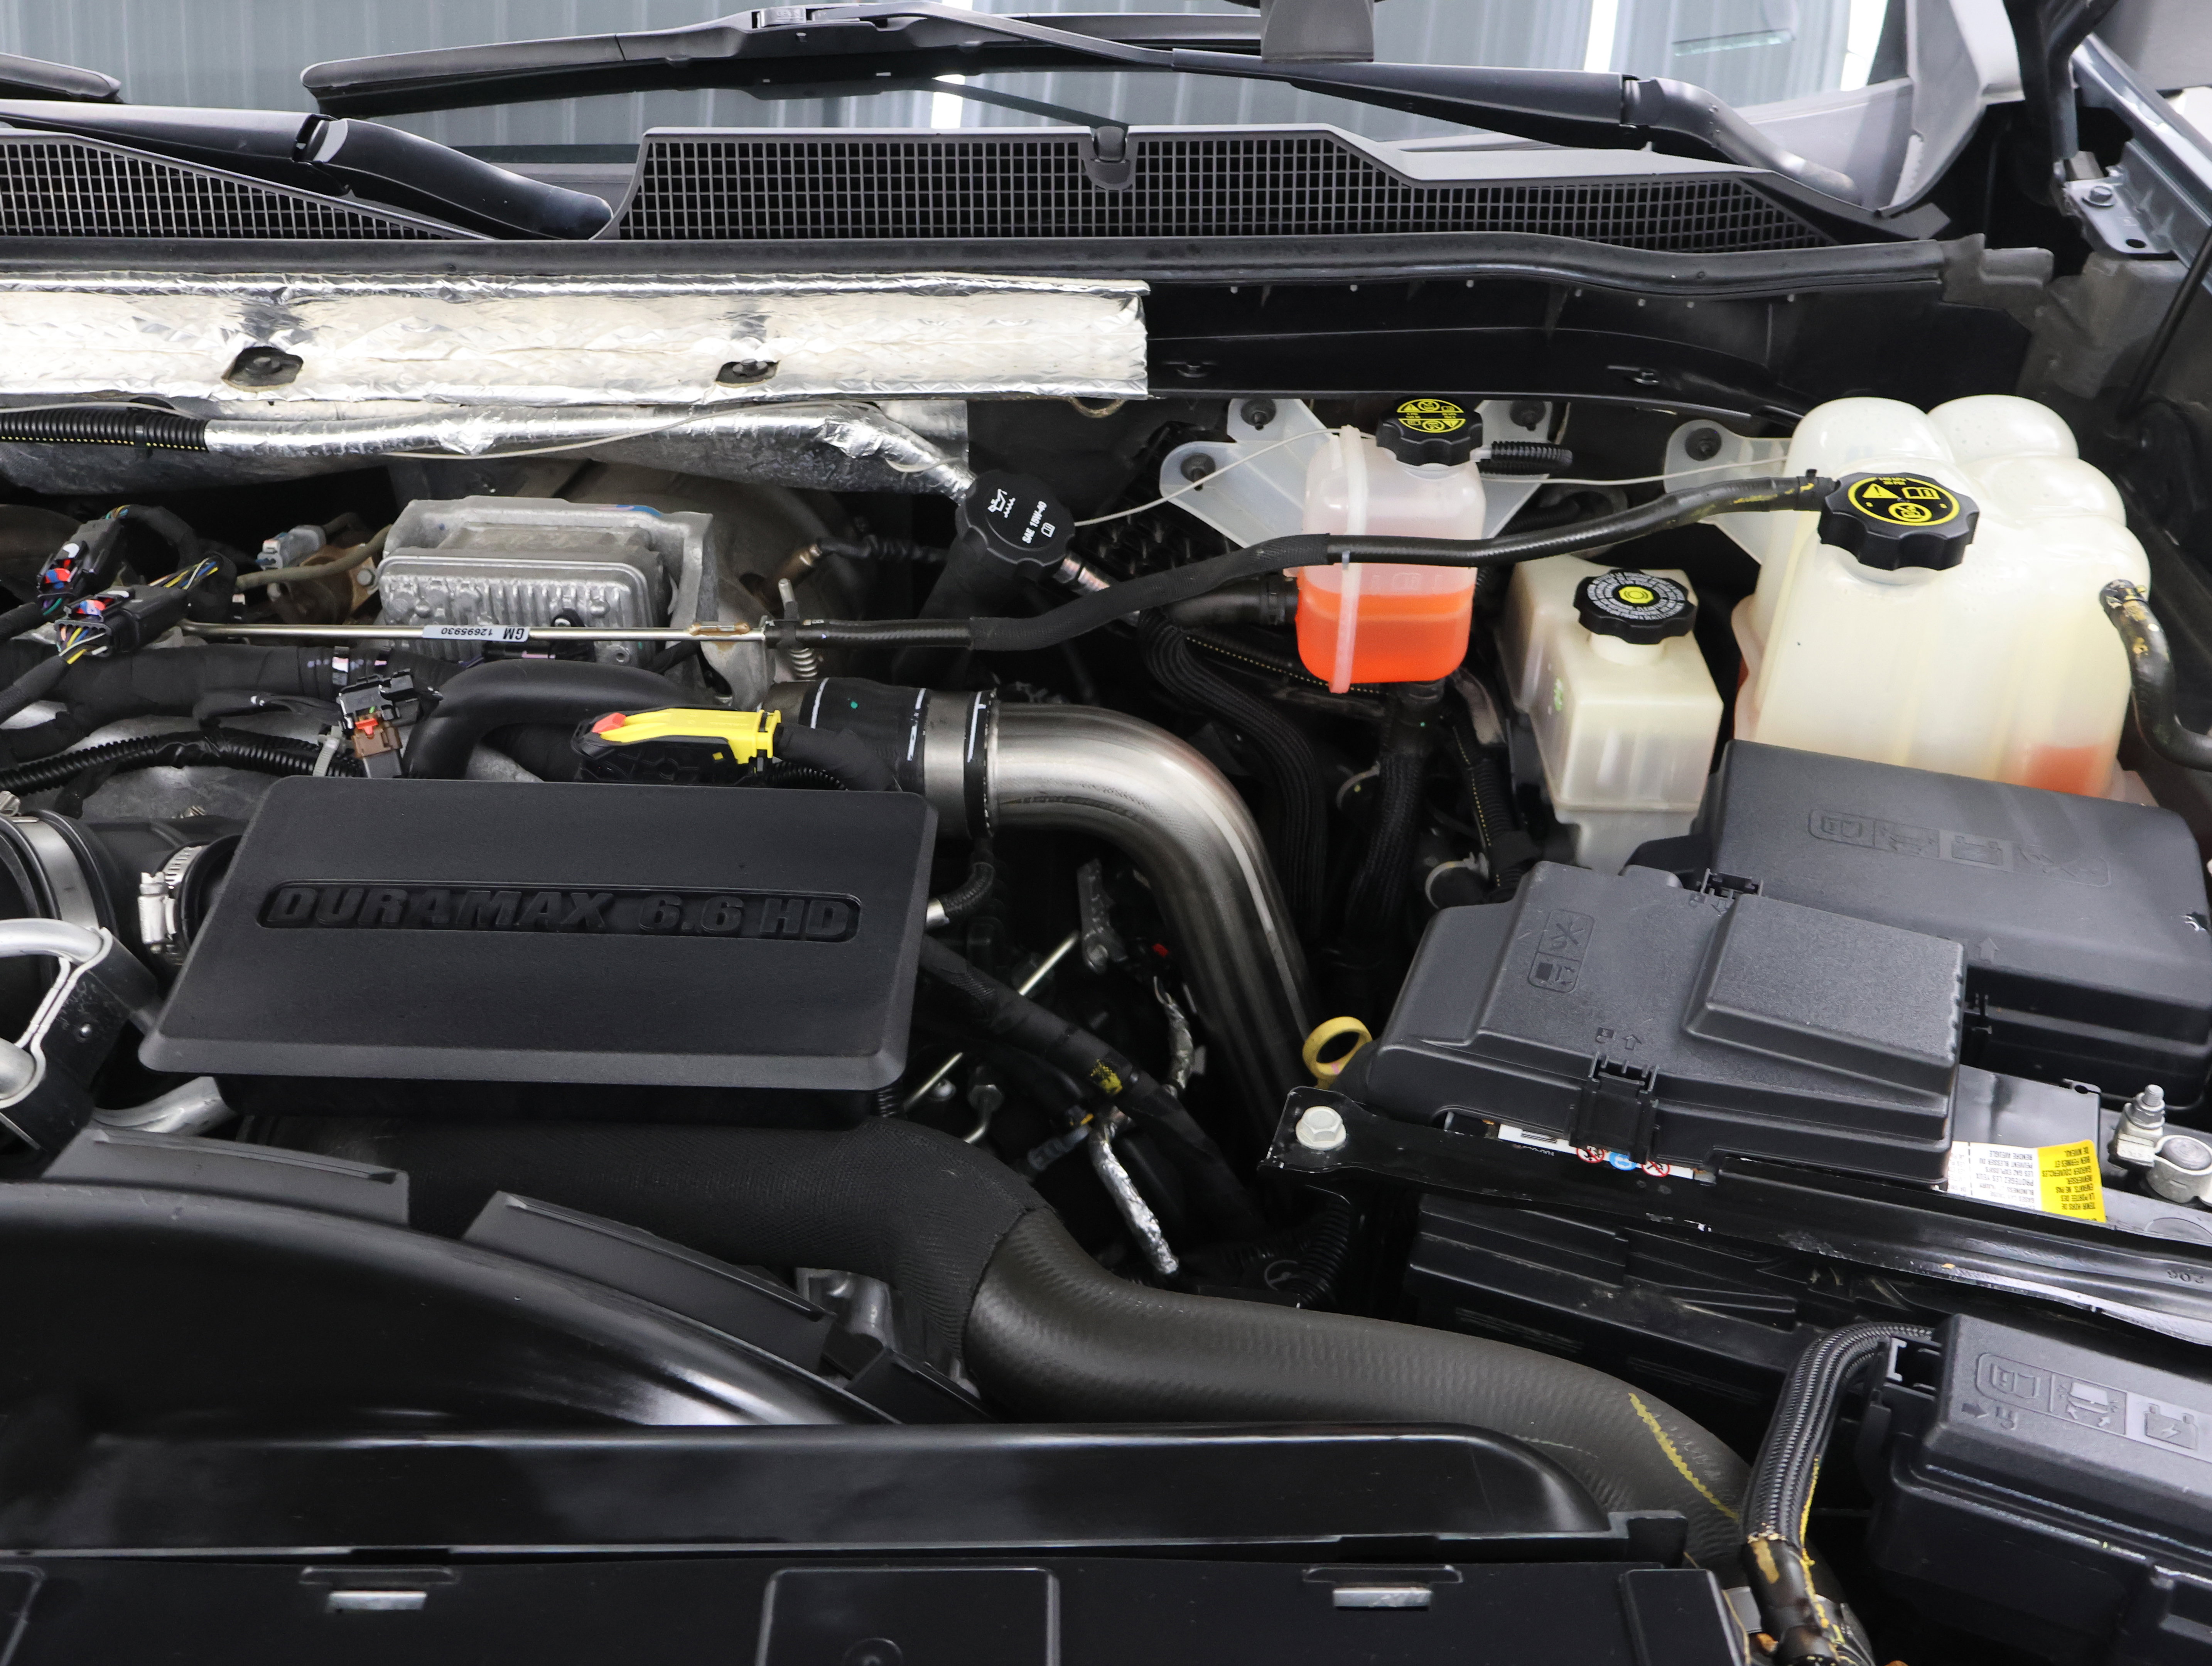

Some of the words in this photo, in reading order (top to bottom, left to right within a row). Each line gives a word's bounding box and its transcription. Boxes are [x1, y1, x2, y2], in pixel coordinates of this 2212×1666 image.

[1022, 527, 1035, 544] SAE
[1029, 501, 1047, 527] 15W-40
[441, 627, 493, 636] 12695930
[503, 627, 525, 640] GM
[267, 887, 614, 927] DURAMAX
[638, 894, 744, 934] 6.6
[760, 897, 851, 936] HD
